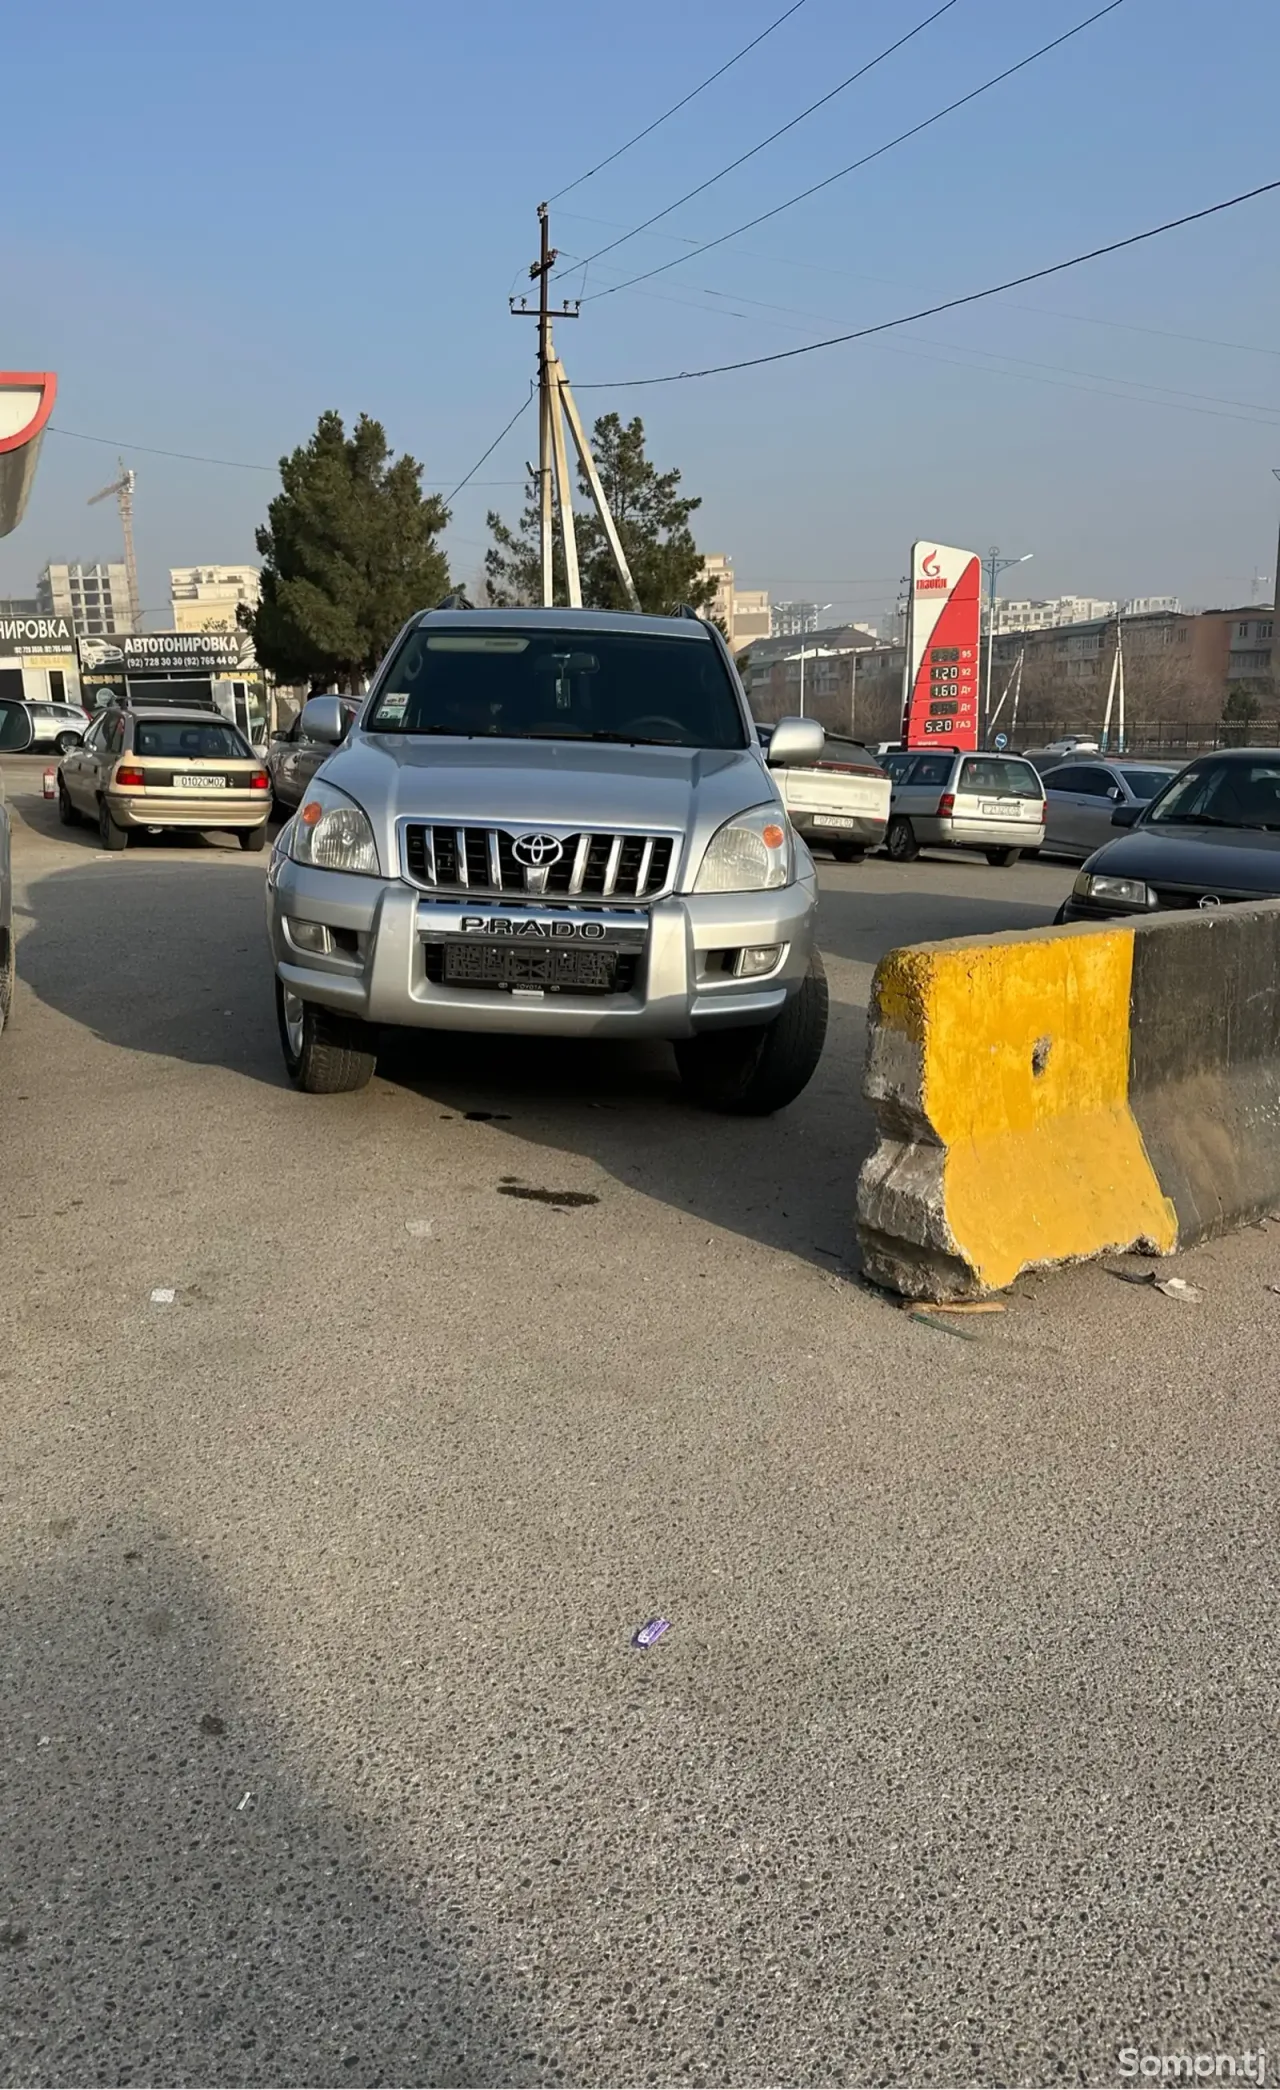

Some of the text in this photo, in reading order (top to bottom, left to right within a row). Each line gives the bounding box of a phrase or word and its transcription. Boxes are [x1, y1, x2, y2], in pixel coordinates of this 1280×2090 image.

[124, 636, 239, 653] АВТОТОНИРОВКА
[961, 650, 972, 659] 95
[127, 655, 238, 669] (92) 728 30 30 (92) 765 44 00
[935, 667, 971, 679] 1.20 92
[935, 684, 958, 697] 1.60
[925, 720, 971, 733] 5.20 ГАЗ
[460, 916, 606, 940] PRADO
